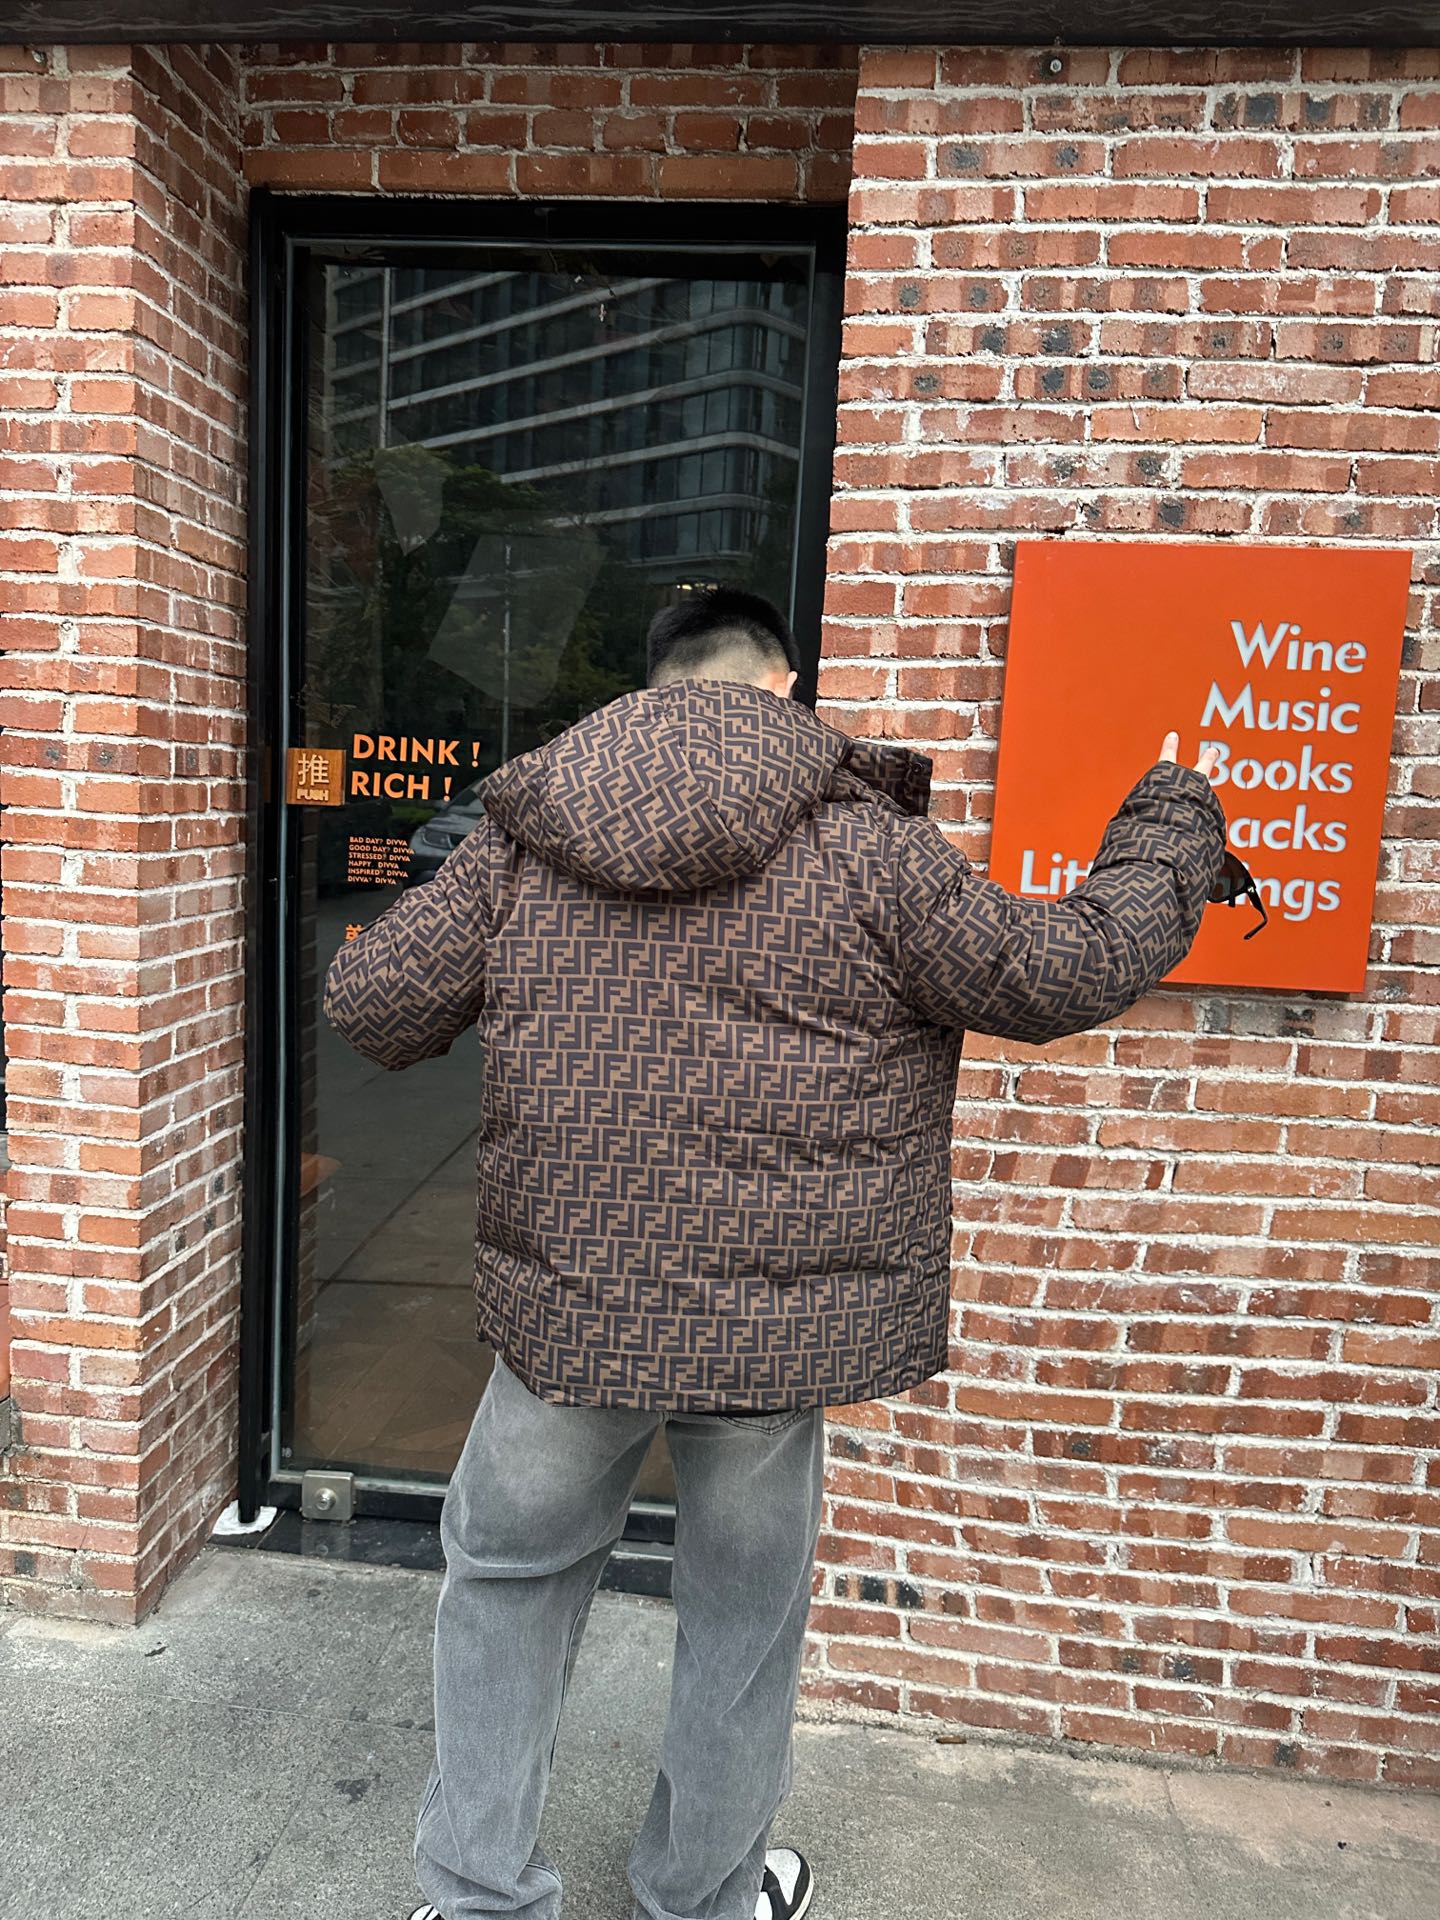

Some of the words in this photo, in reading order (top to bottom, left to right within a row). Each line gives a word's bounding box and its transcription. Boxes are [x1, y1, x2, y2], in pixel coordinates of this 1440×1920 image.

[1230, 620, 1367, 674] Wine
[1199, 679, 1361, 734] Music
[353, 734, 460, 766] DRINK
[298, 753, 330, 786] 推
[1198, 740, 1354, 794] Books
[296, 788, 329, 801] PUSH
[351, 771, 430, 800] RICH
[1228, 804, 1348, 854] acks
[348, 844, 371, 852] GOOD
